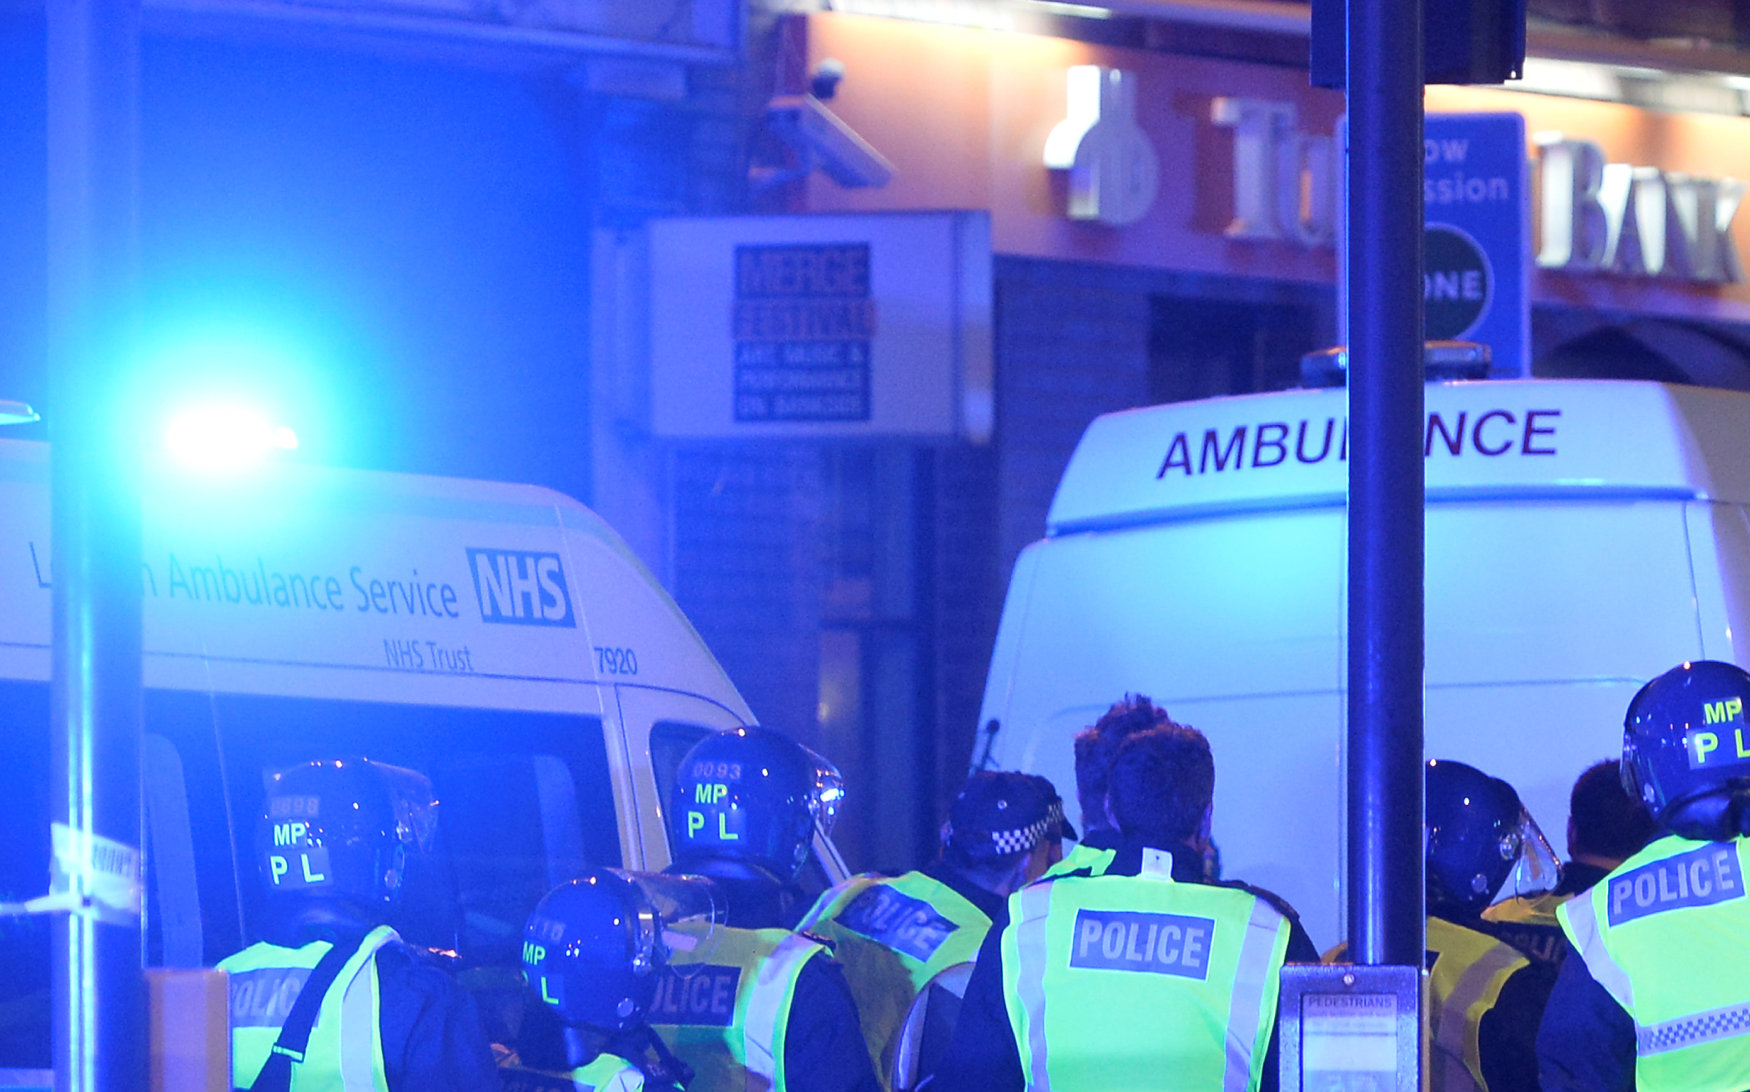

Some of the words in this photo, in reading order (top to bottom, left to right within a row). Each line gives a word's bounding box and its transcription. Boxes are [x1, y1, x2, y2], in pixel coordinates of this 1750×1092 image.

[1424, 139, 1468, 162] ow
[1156, 409, 1561, 480] AMBUNCE
[168, 552, 342, 612] Ambulance
[349, 565, 459, 619] Service
[473, 552, 567, 621] NHS
[383, 638, 424, 669] NHS
[425, 641, 475, 673] Trust
[593, 647, 639, 675] 7920
[1704, 698, 1742, 724] MP
[1695, 732, 1719, 764] P
[695, 783, 728, 804] MP
[273, 823, 306, 847] MP
[688, 811, 705, 839] P
[719, 812, 739, 840] L
[270, 855, 288, 886] P
[300, 853, 325, 883] L
[1613, 849, 1735, 915] POLICE
[522, 941, 546, 966] MP
[1079, 919, 1205, 967] POLICE
[540, 976, 559, 1005] L
[1308, 996, 1393, 1008] PEDESTRIANS
